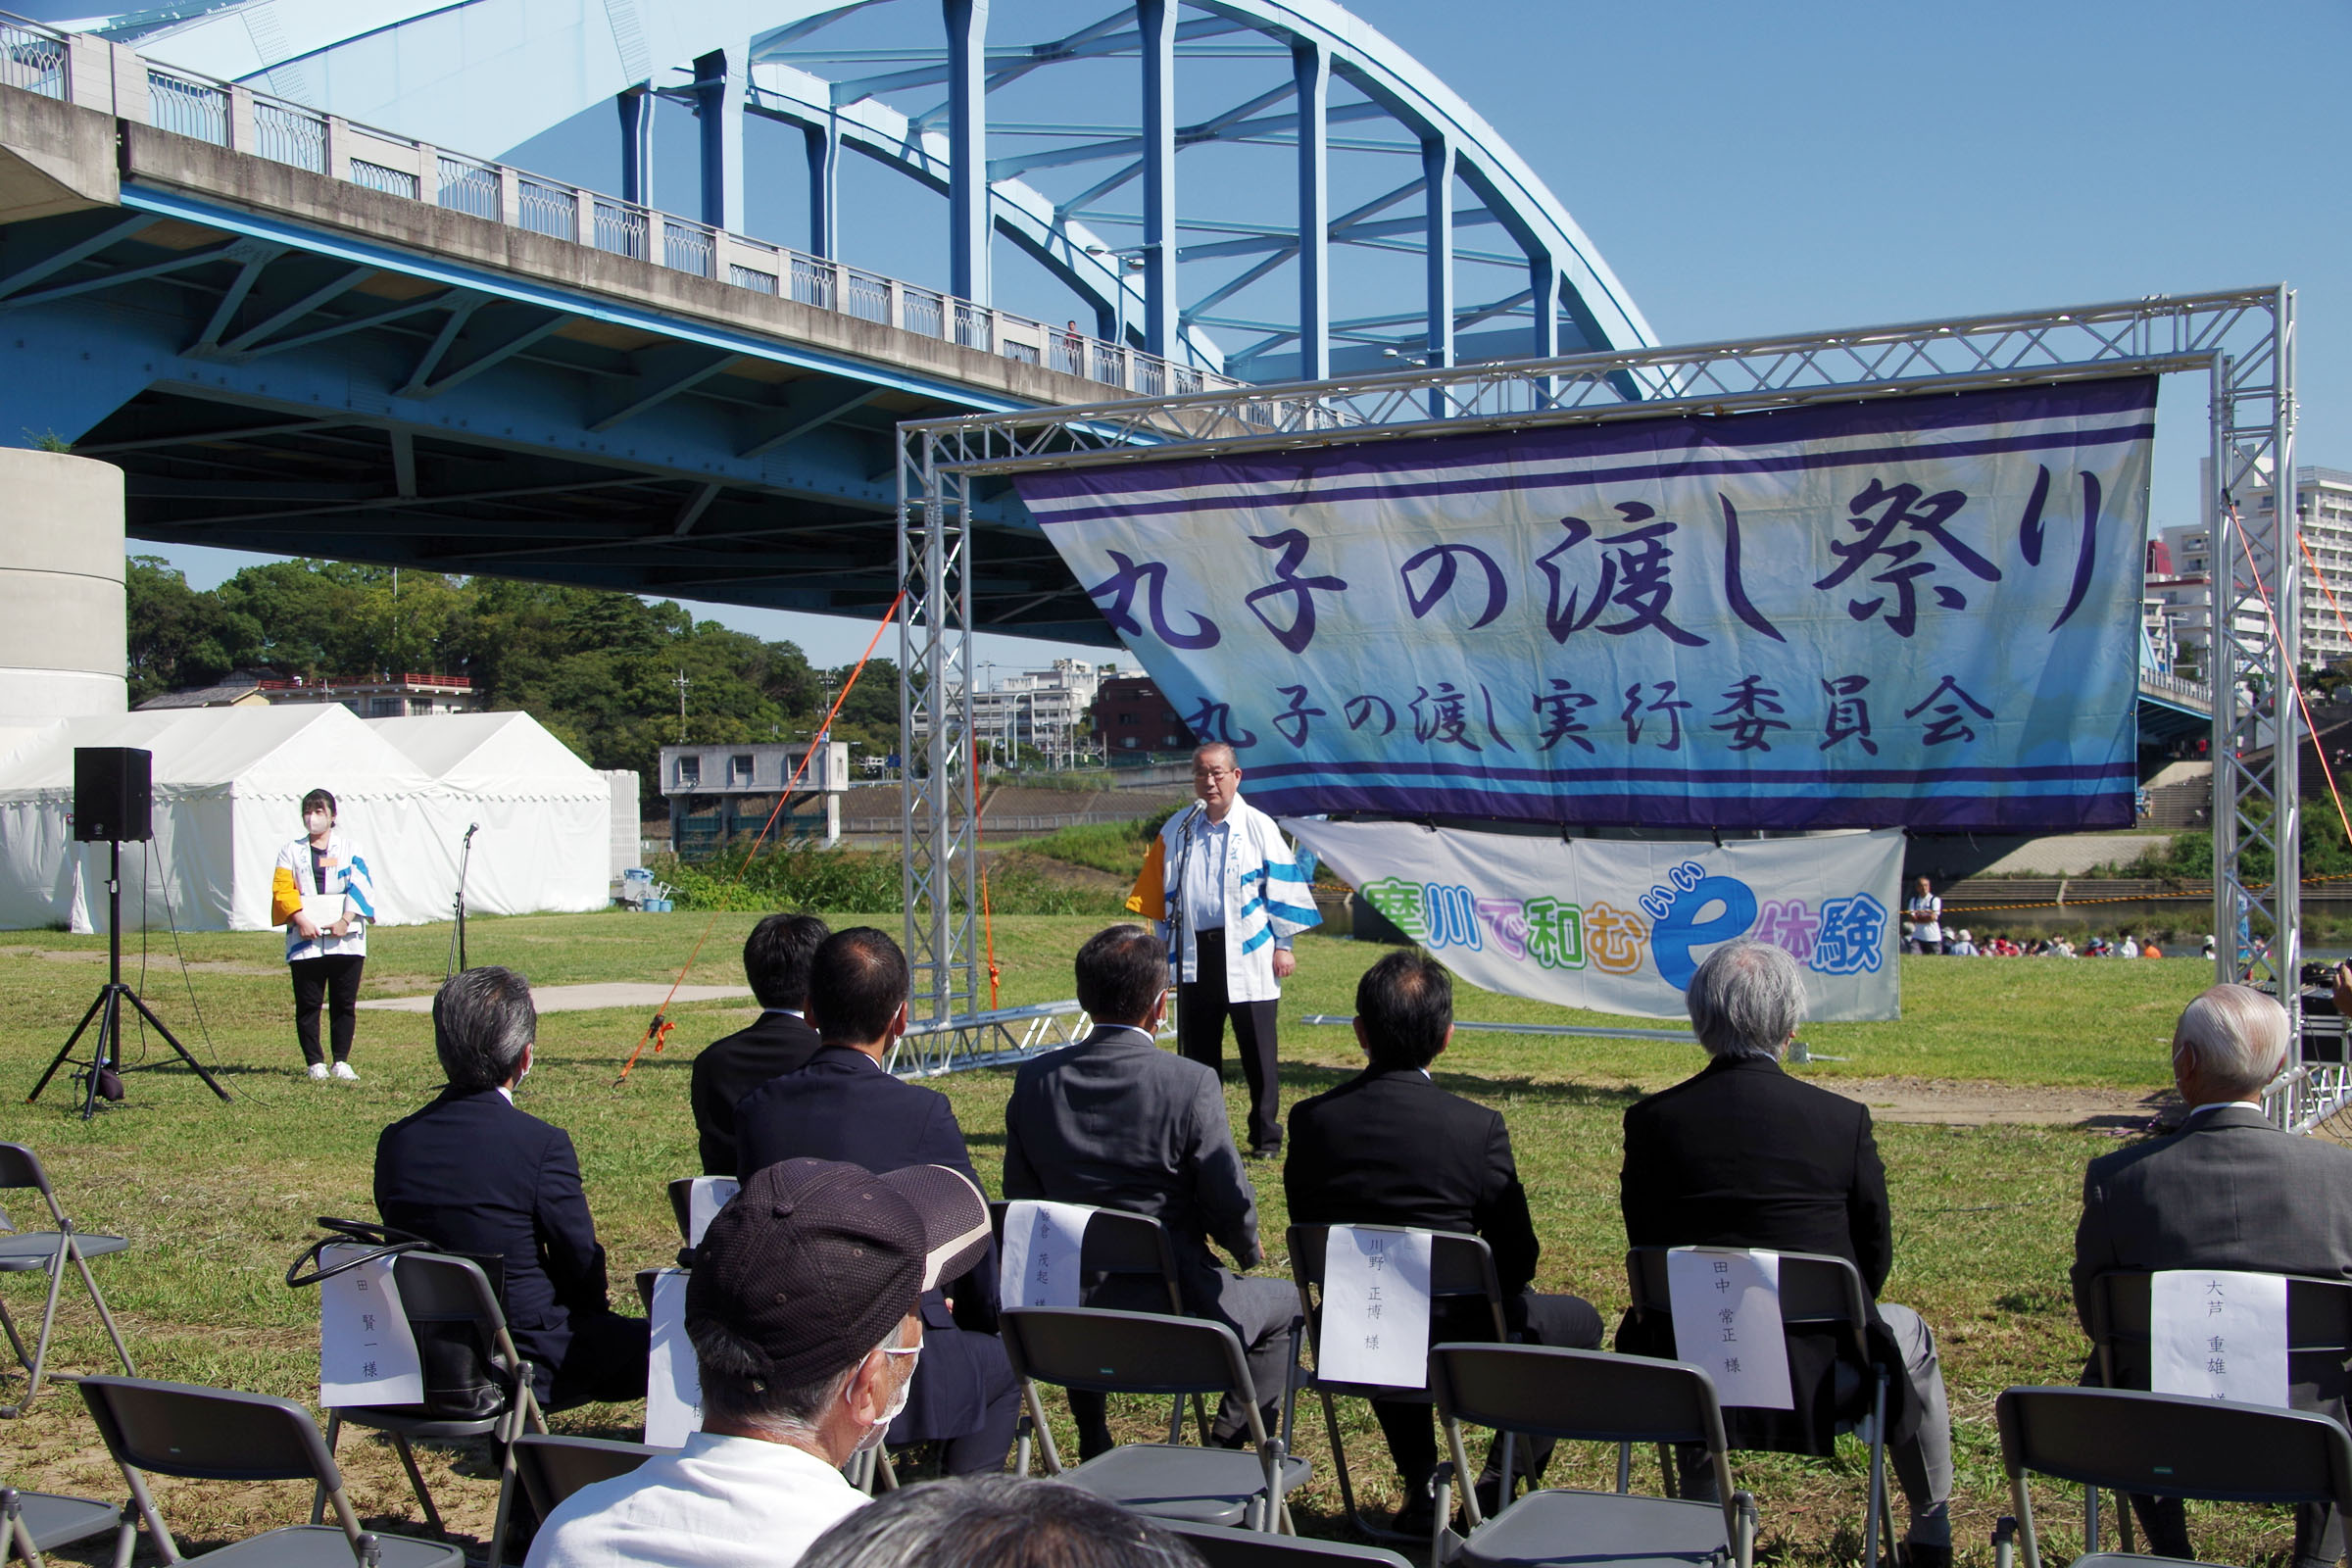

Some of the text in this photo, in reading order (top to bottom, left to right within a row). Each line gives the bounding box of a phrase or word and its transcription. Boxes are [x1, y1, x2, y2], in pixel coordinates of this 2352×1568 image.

[1093, 464, 2100, 654] 丸子の渡し祭り
[1183, 672, 1994, 755] 丸子の渡し実行委員会
